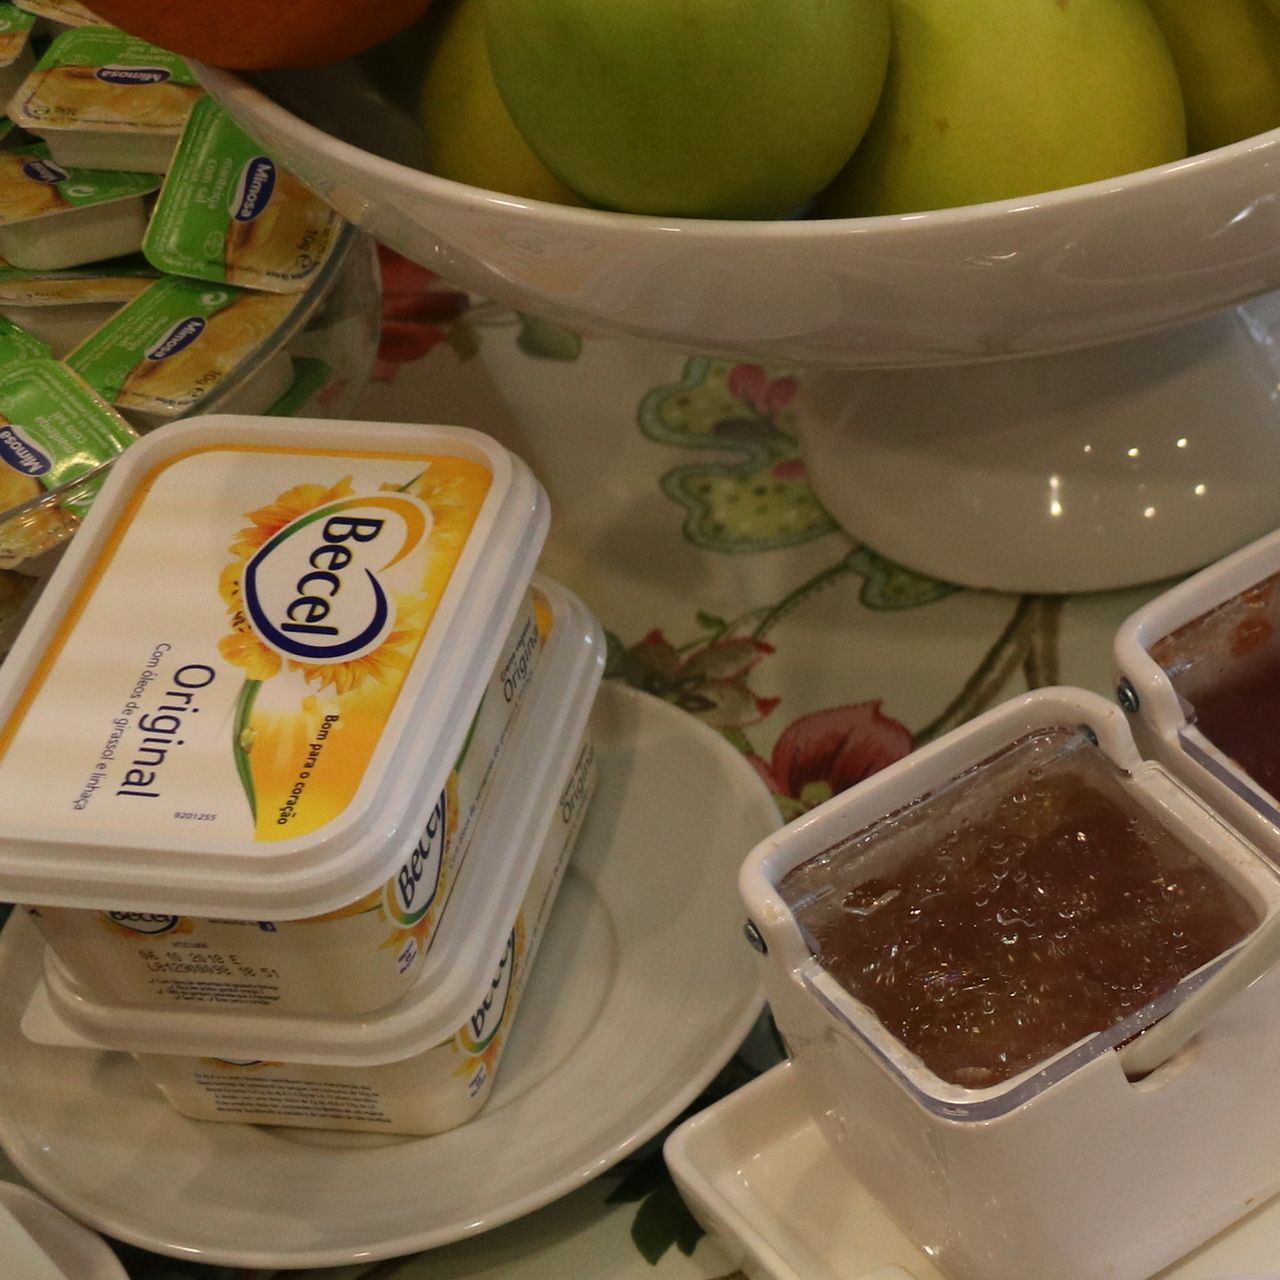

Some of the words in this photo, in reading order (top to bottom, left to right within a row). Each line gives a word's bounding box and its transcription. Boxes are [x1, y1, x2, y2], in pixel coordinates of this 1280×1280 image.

[101, 70, 163, 82] Mimosa
[239, 163, 273, 218] Mimosa
[154, 320, 204, 358] Mimosa
[0, 429, 45, 473] Mimosa
[281, 516, 385, 636] Becel
[147, 643, 172, 668] Com
[129, 670, 159, 700] óleos
[122, 701, 140, 716] de
[100, 717, 132, 761] girassol
[116, 664, 216, 798] Original
[316, 714, 340, 741] Bom
[96, 762, 107, 770] e
[303, 743, 323, 769] para
[74, 772, 108, 811] linhaça
[299, 771, 311, 779] o
[277, 781, 306, 825] coração
